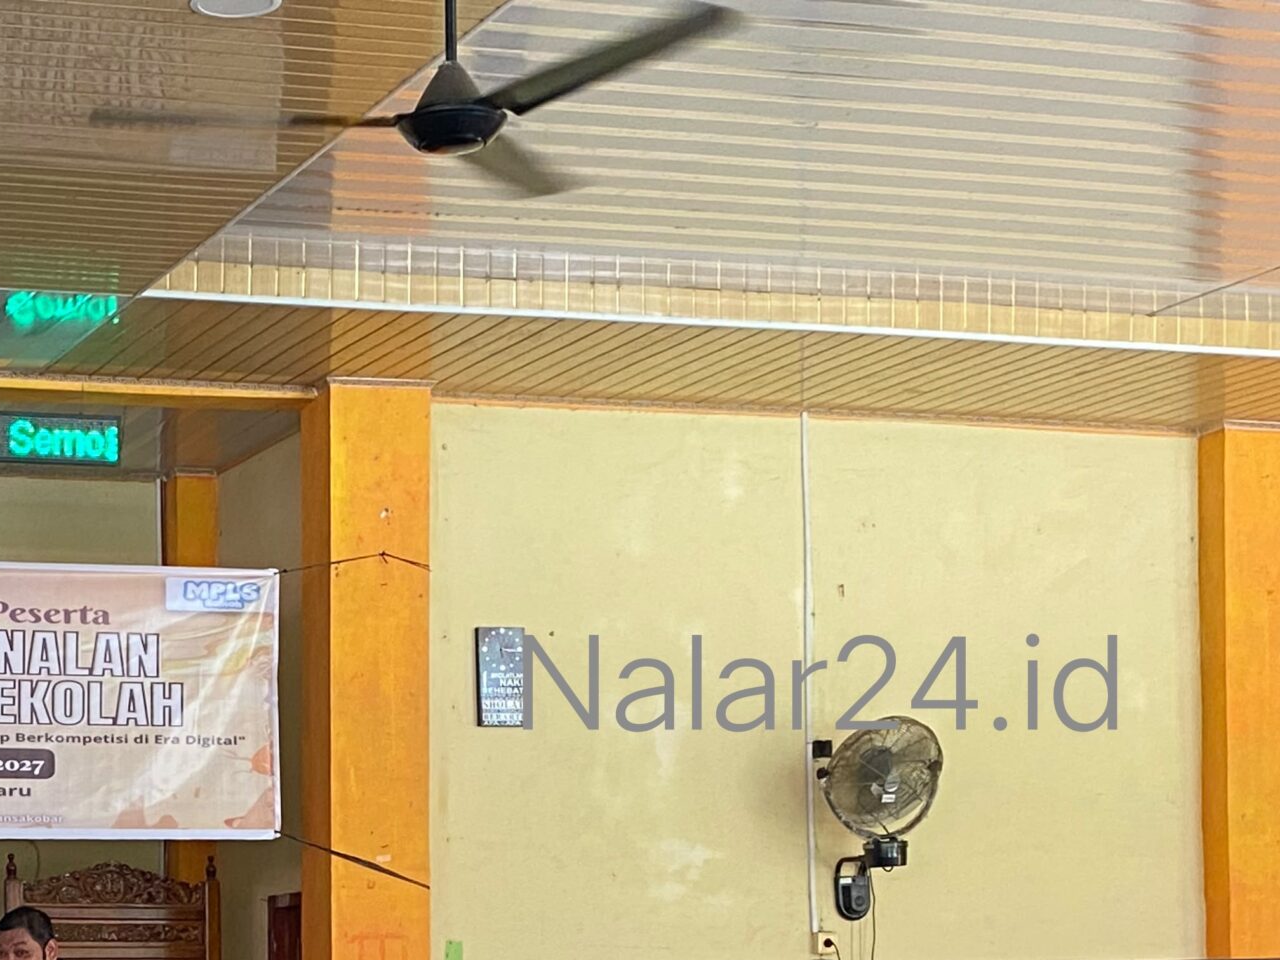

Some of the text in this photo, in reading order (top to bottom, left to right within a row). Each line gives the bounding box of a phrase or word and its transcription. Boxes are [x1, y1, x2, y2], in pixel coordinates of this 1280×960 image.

[184, 580, 260, 602] MPLS
[15, 733, 128, 746] Berkompetisi
[133, 734, 149, 745] di
[154, 735, 180, 745] Era
[185, 735, 246, 748] Digital"
